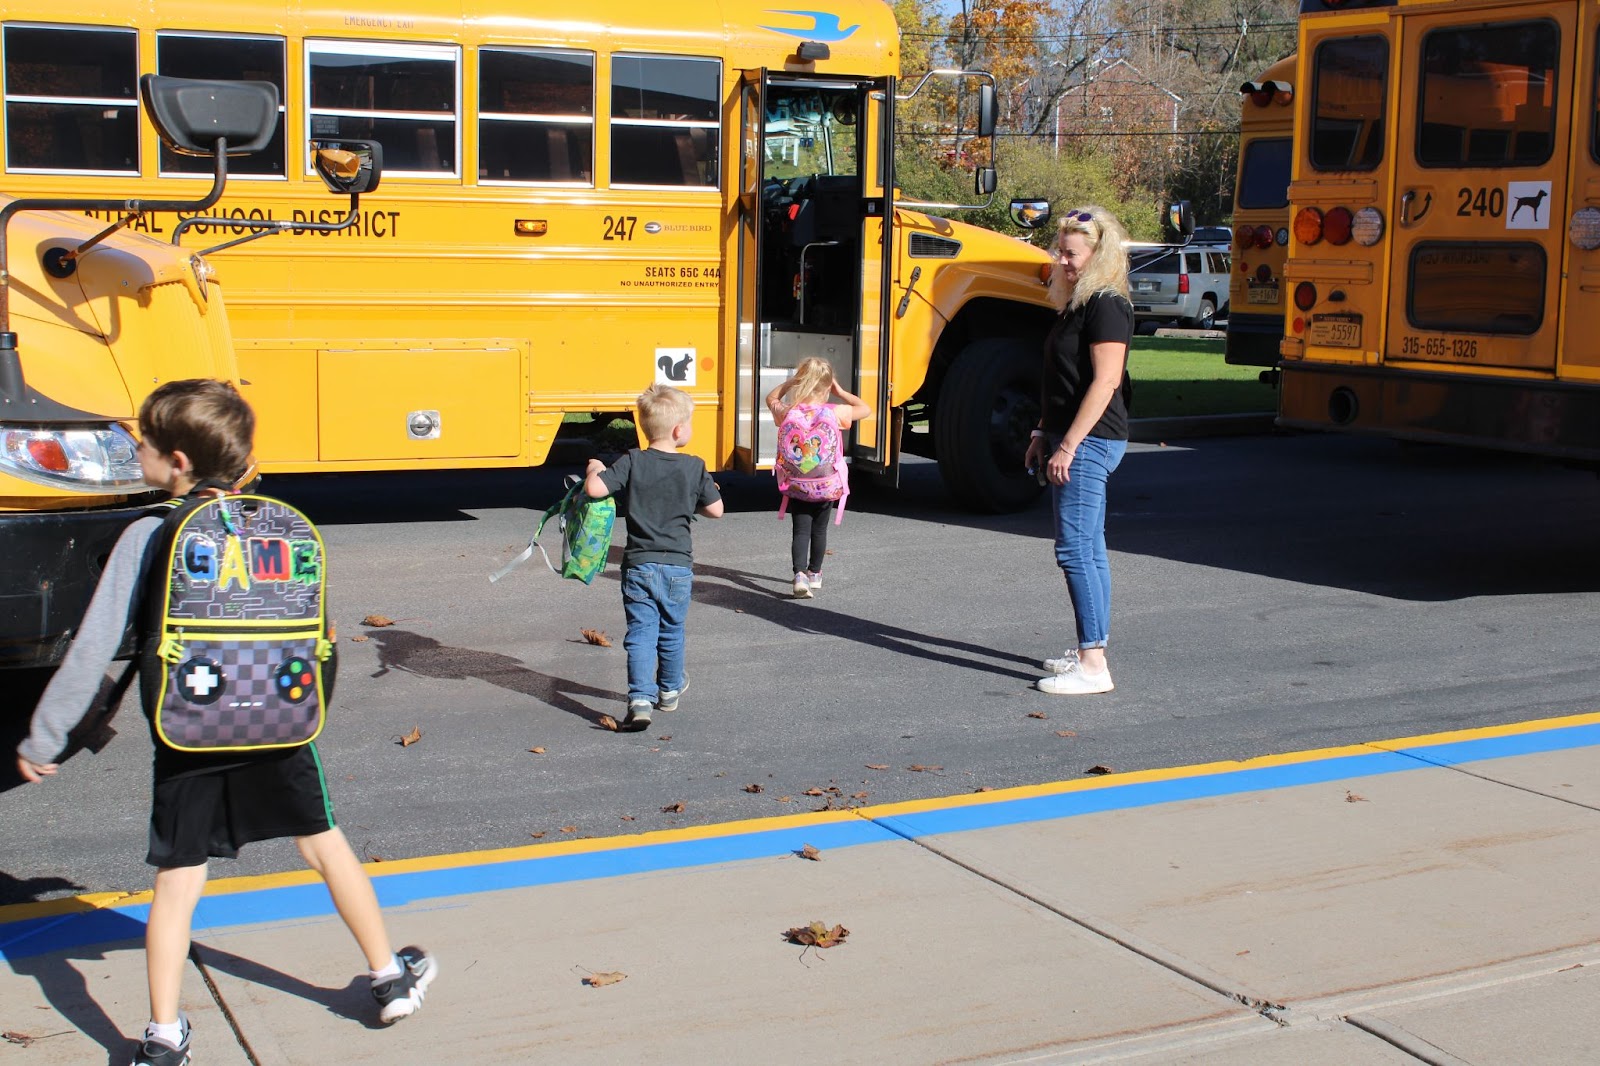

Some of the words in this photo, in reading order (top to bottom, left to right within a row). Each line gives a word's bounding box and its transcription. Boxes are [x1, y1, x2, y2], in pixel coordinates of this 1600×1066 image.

[344, 15, 392, 28] EMERGENCY
[397, 18, 414, 29] EXIT
[1456, 187, 1505, 218] 240
[292, 209, 401, 238] DISTRICT
[603, 215, 638, 241] 247
[664, 224, 688, 232] BLUE
[645, 266, 676, 278] SEATS
[680, 267, 699, 278] 65C
[702, 267, 721, 279] 44A
[633, 280, 693, 288] UNAUTHORIZED
[1402, 336, 1478, 358] 315-655-1326
[182, 532, 321, 591] GAME
